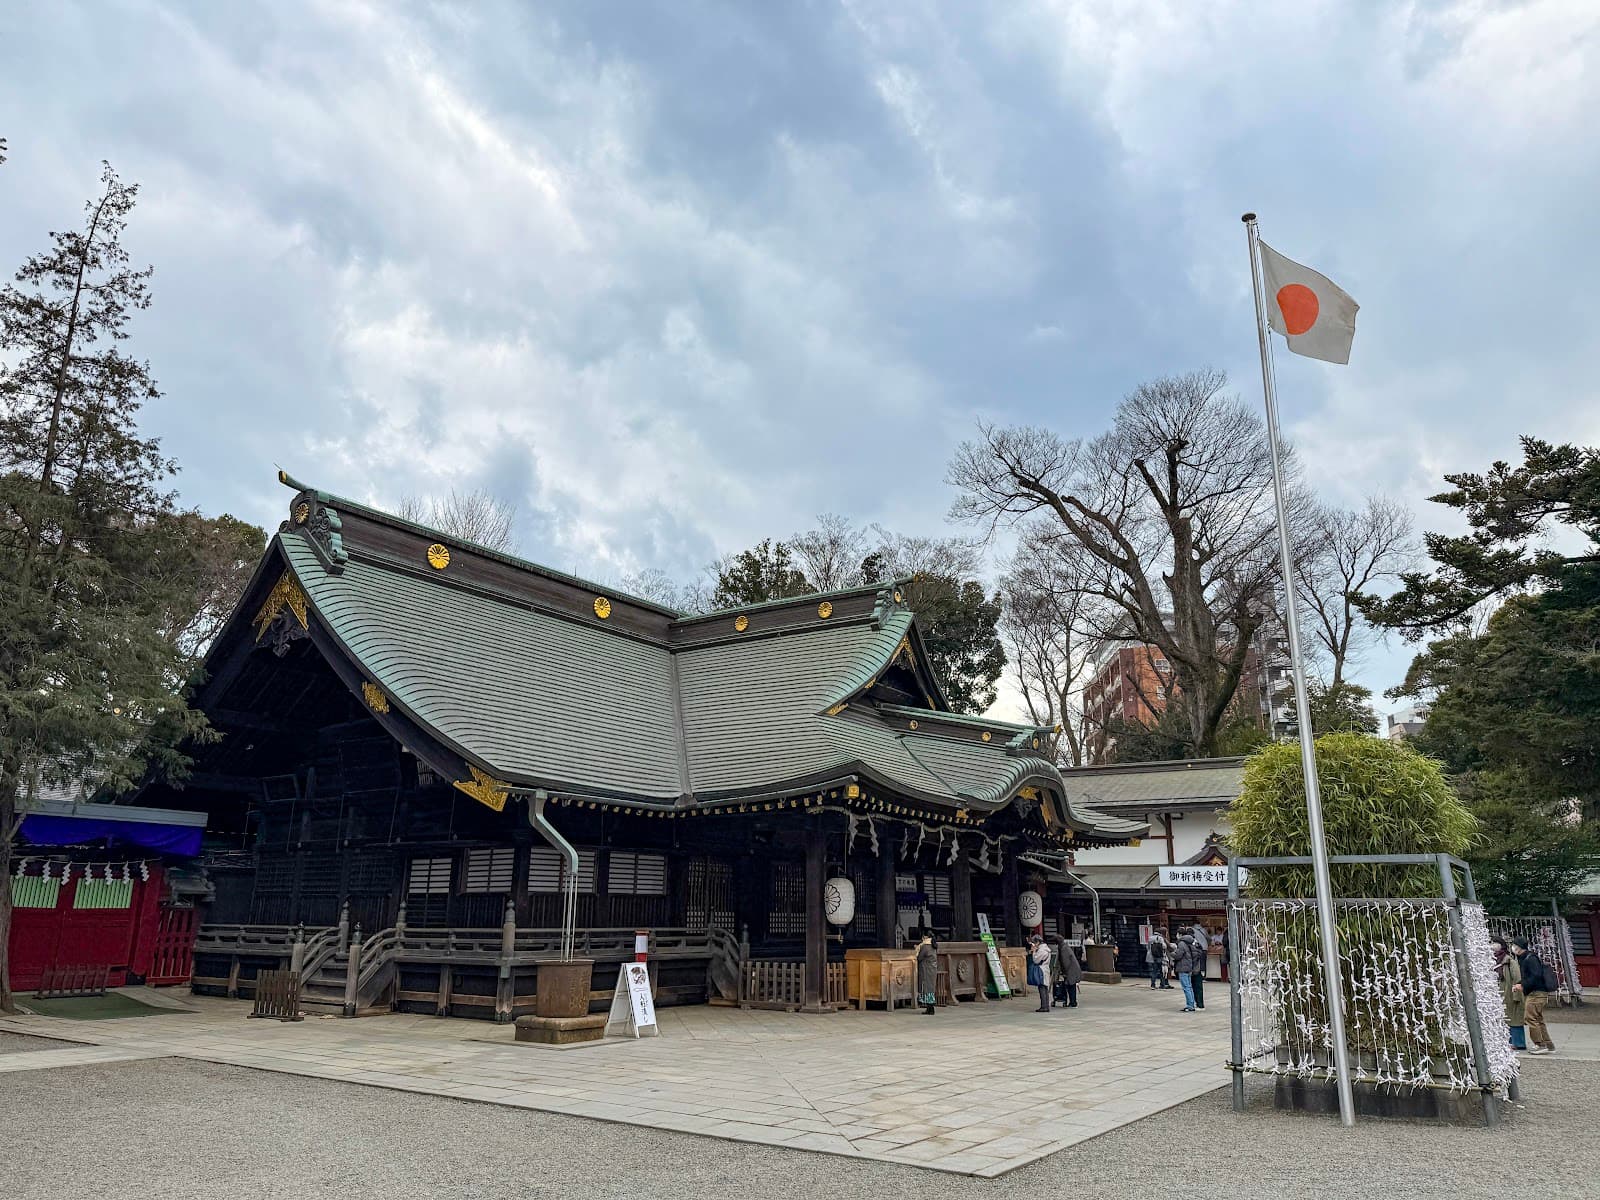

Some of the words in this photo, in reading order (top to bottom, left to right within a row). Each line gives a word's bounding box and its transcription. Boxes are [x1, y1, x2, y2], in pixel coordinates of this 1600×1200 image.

[1169, 870, 1228, 882] 御祈祷受付
